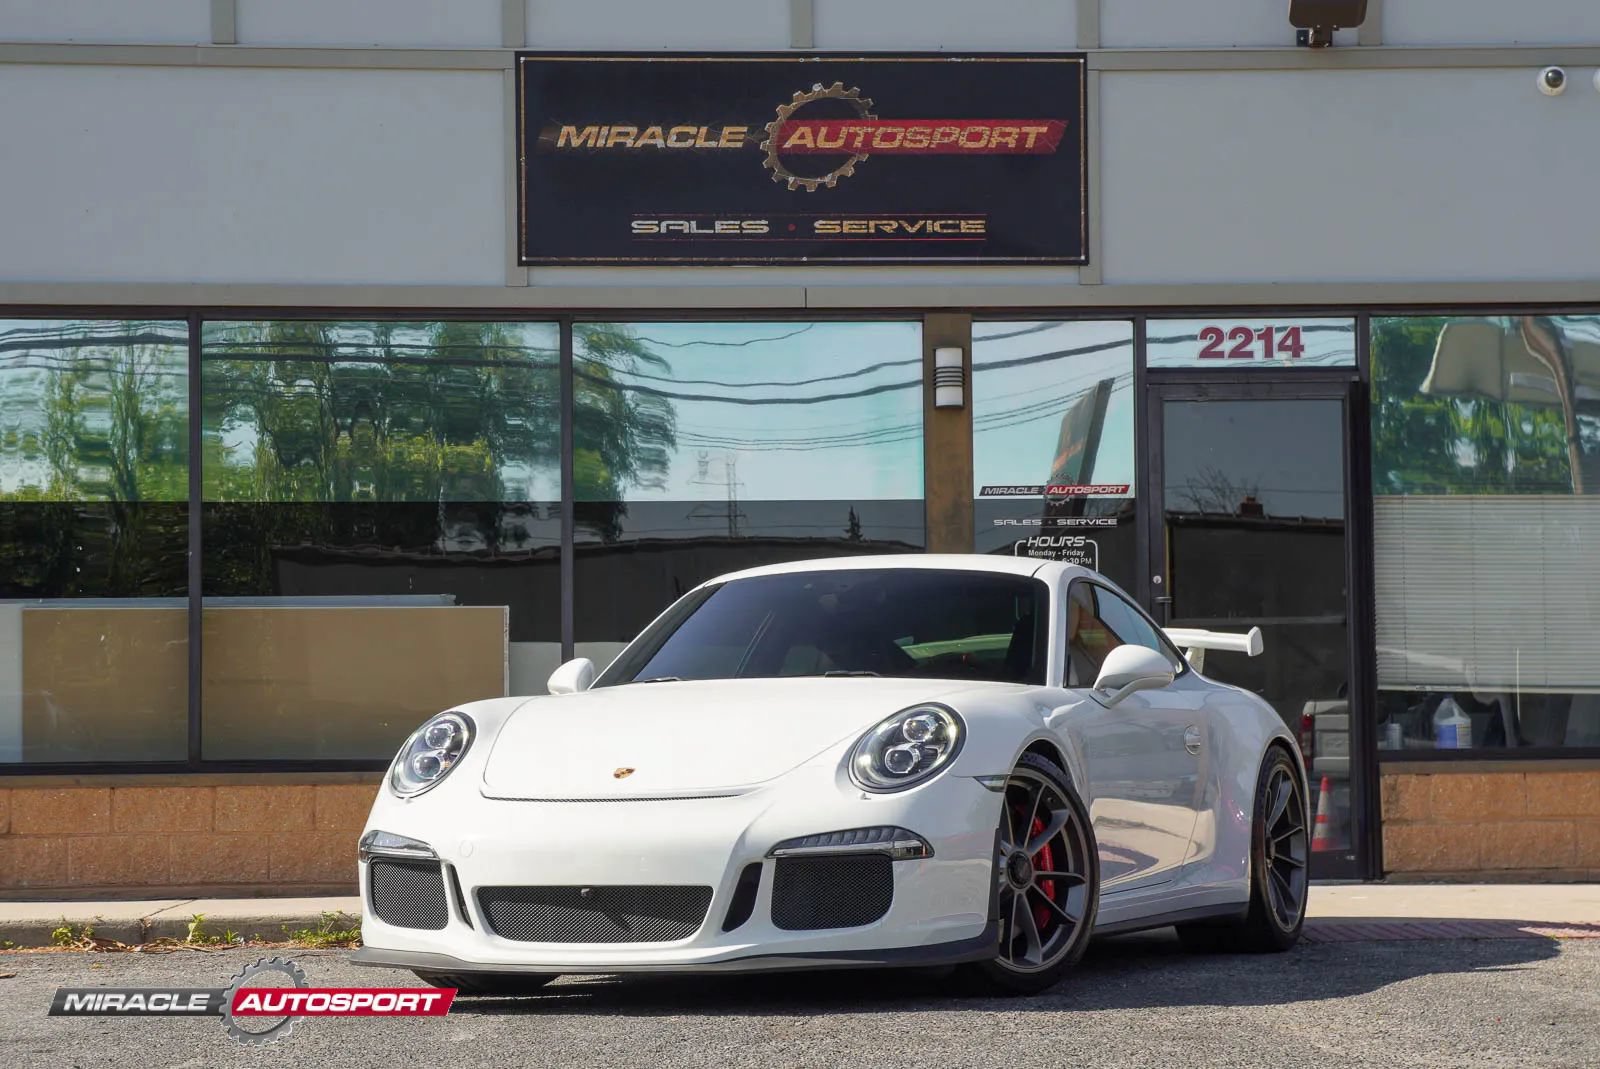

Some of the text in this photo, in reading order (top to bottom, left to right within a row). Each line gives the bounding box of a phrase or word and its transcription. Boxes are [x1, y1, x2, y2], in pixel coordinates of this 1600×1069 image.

[556, 125, 1048, 149] MIRACLE AUTOSPORT
[631, 219, 986, 234] SALES SERVICE
[1199, 326, 1305, 359] 2214
[1049, 486, 1126, 494] AUTOSPORT
[1027, 536, 1086, 547] HOURS
[1028, 549, 1056, 557] Monday
[1062, 549, 1085, 557] Friday
